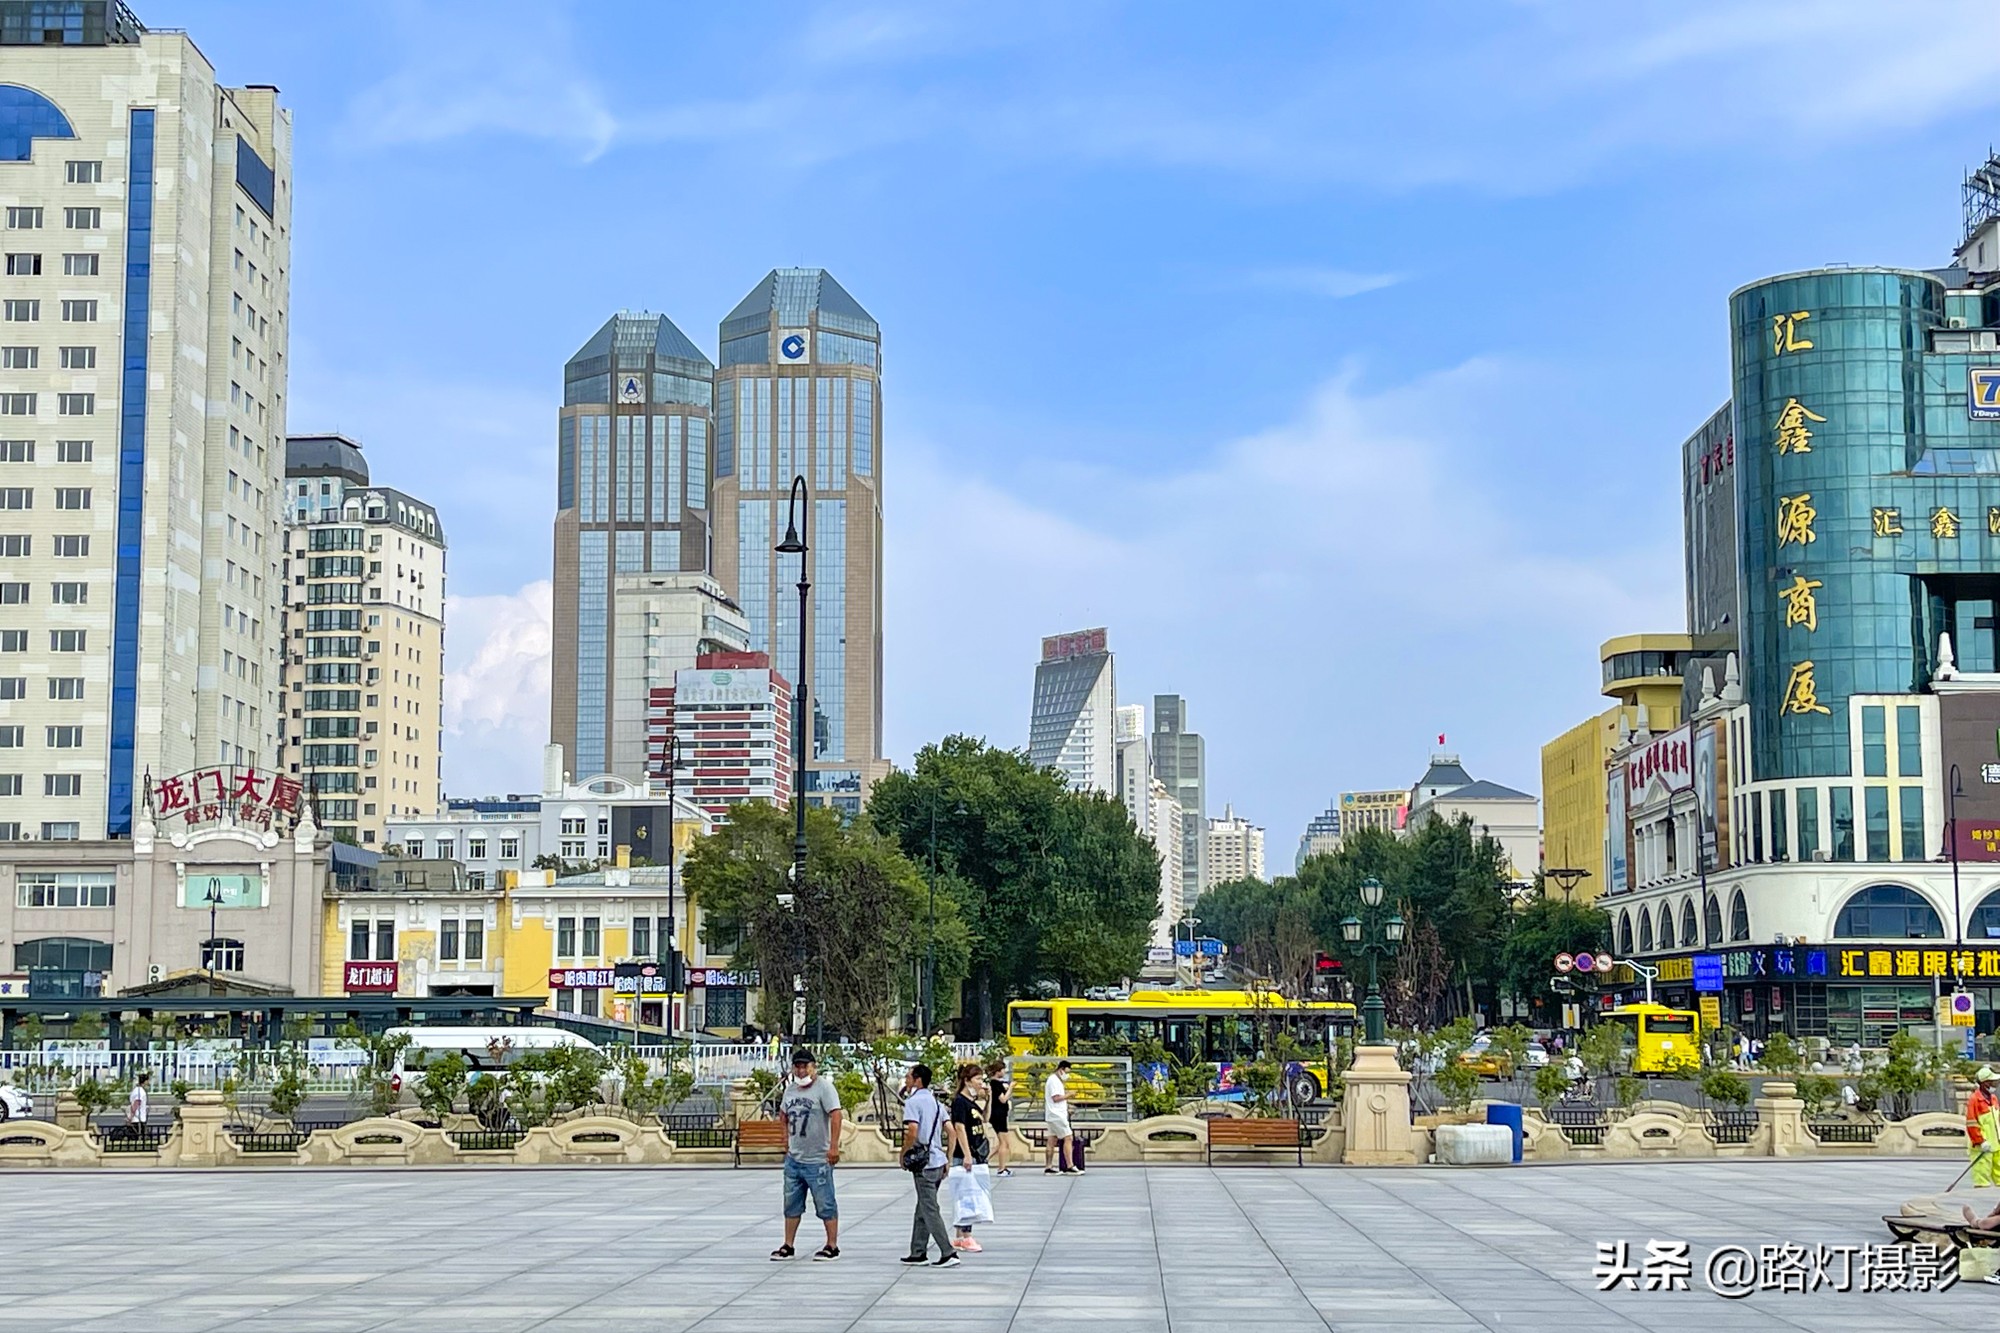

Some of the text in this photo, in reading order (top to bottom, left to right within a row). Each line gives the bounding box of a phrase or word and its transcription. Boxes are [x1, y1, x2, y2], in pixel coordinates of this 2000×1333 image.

[1773, 311, 1831, 716] 汇鑫源商厦
[154, 769, 303, 815] 龙门大厦
[347, 967, 394, 985] 龙门超市
